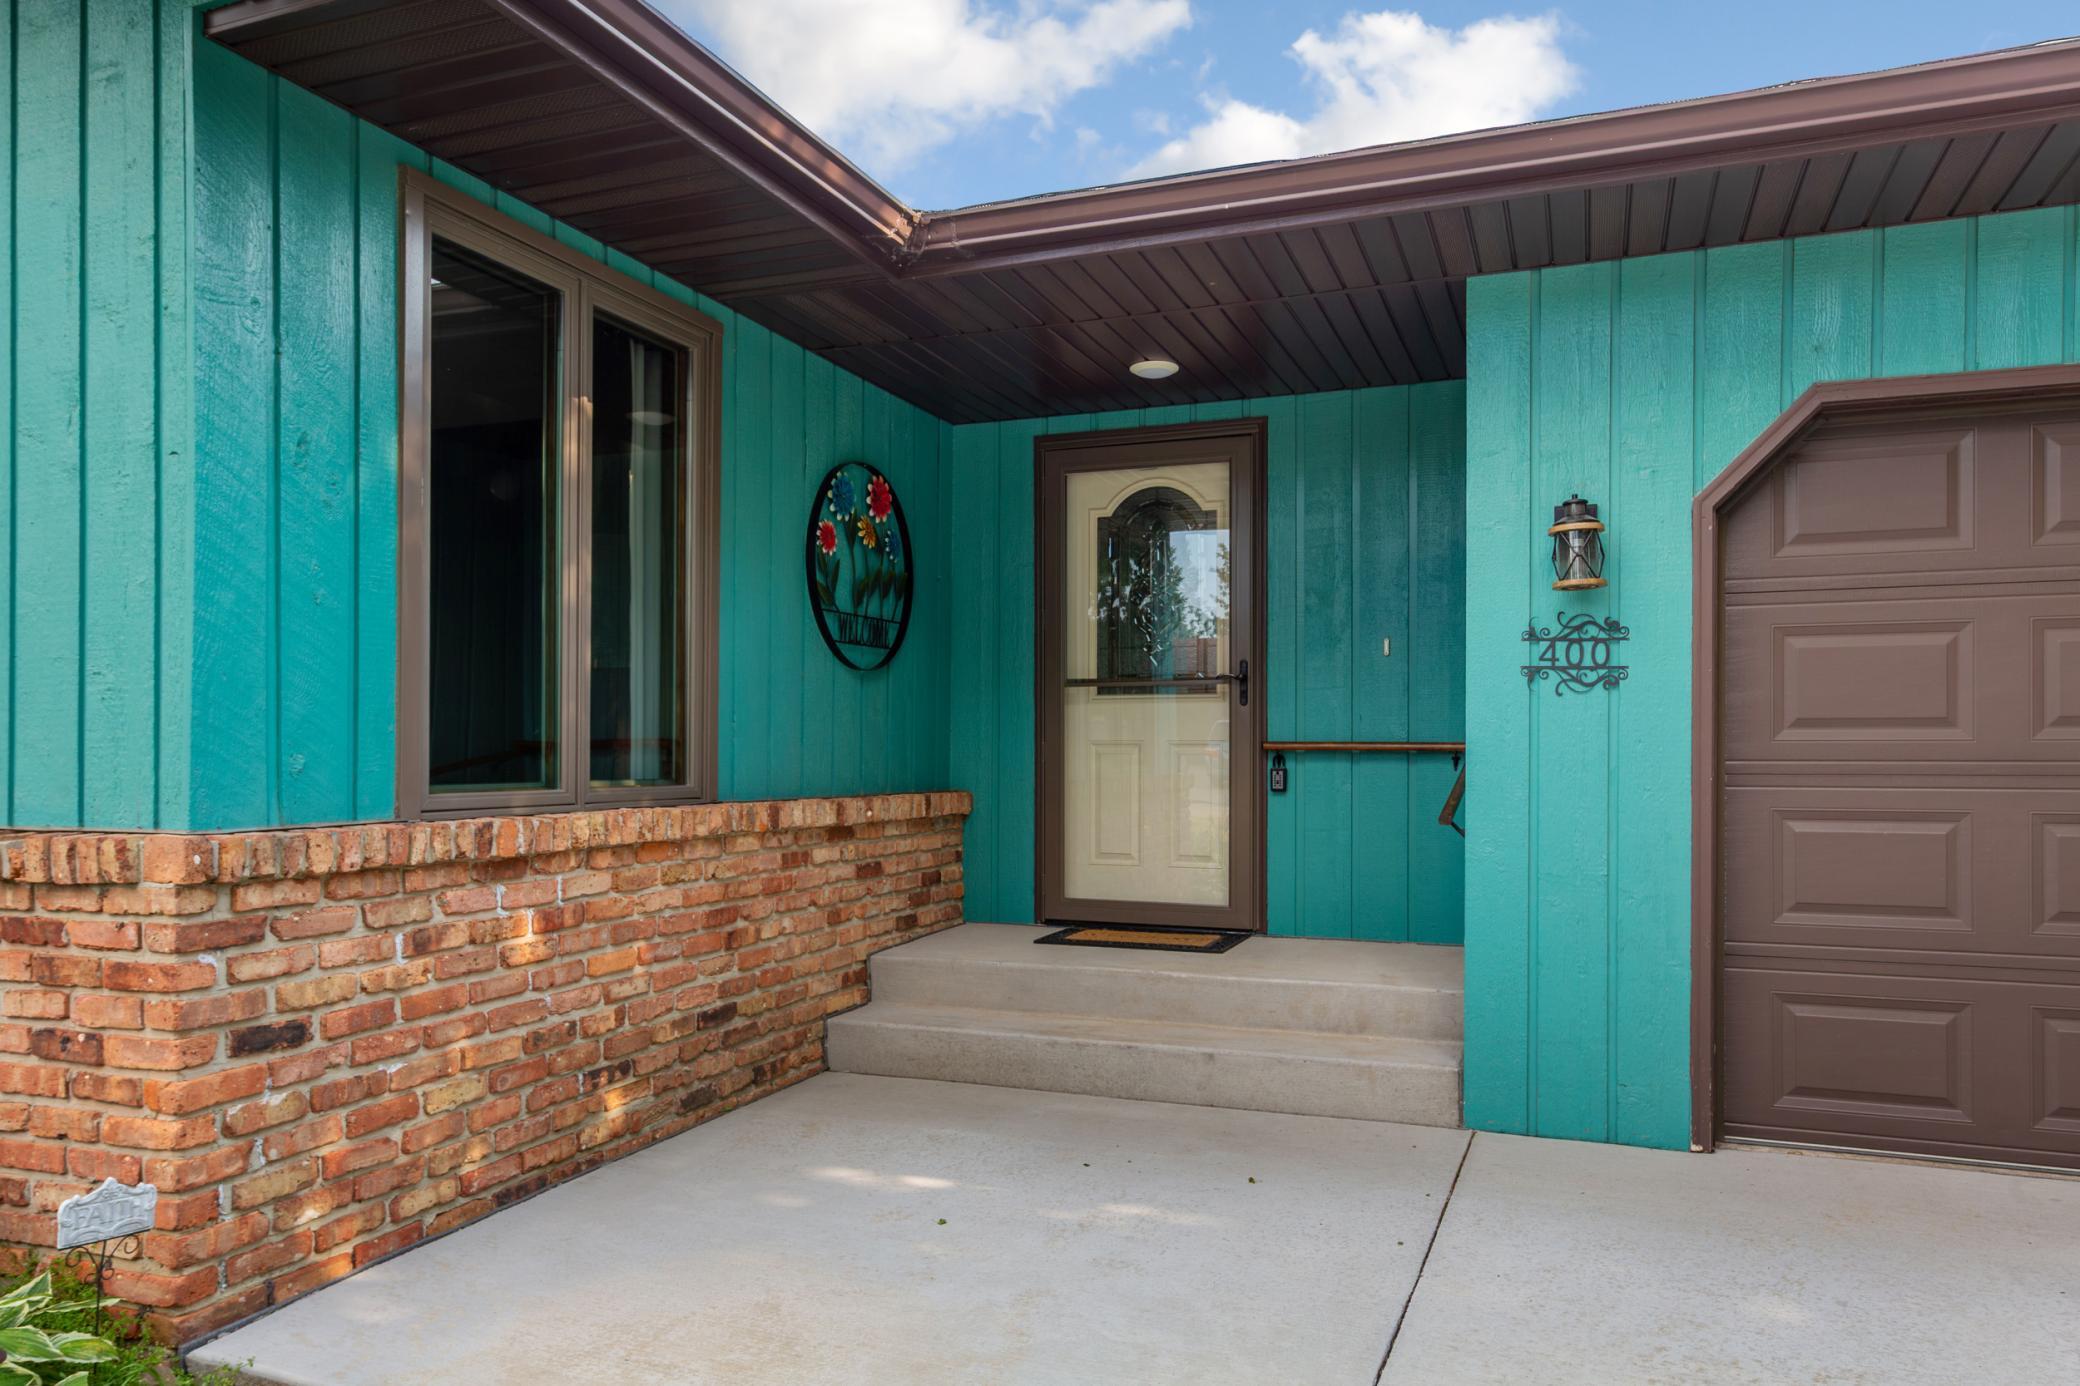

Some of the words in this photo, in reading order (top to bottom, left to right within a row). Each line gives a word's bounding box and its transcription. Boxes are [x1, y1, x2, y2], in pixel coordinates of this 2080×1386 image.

[839, 614, 889, 648] WELCOME
[1538, 639, 1610, 667] 400
[72, 1198, 146, 1230] FAITH
